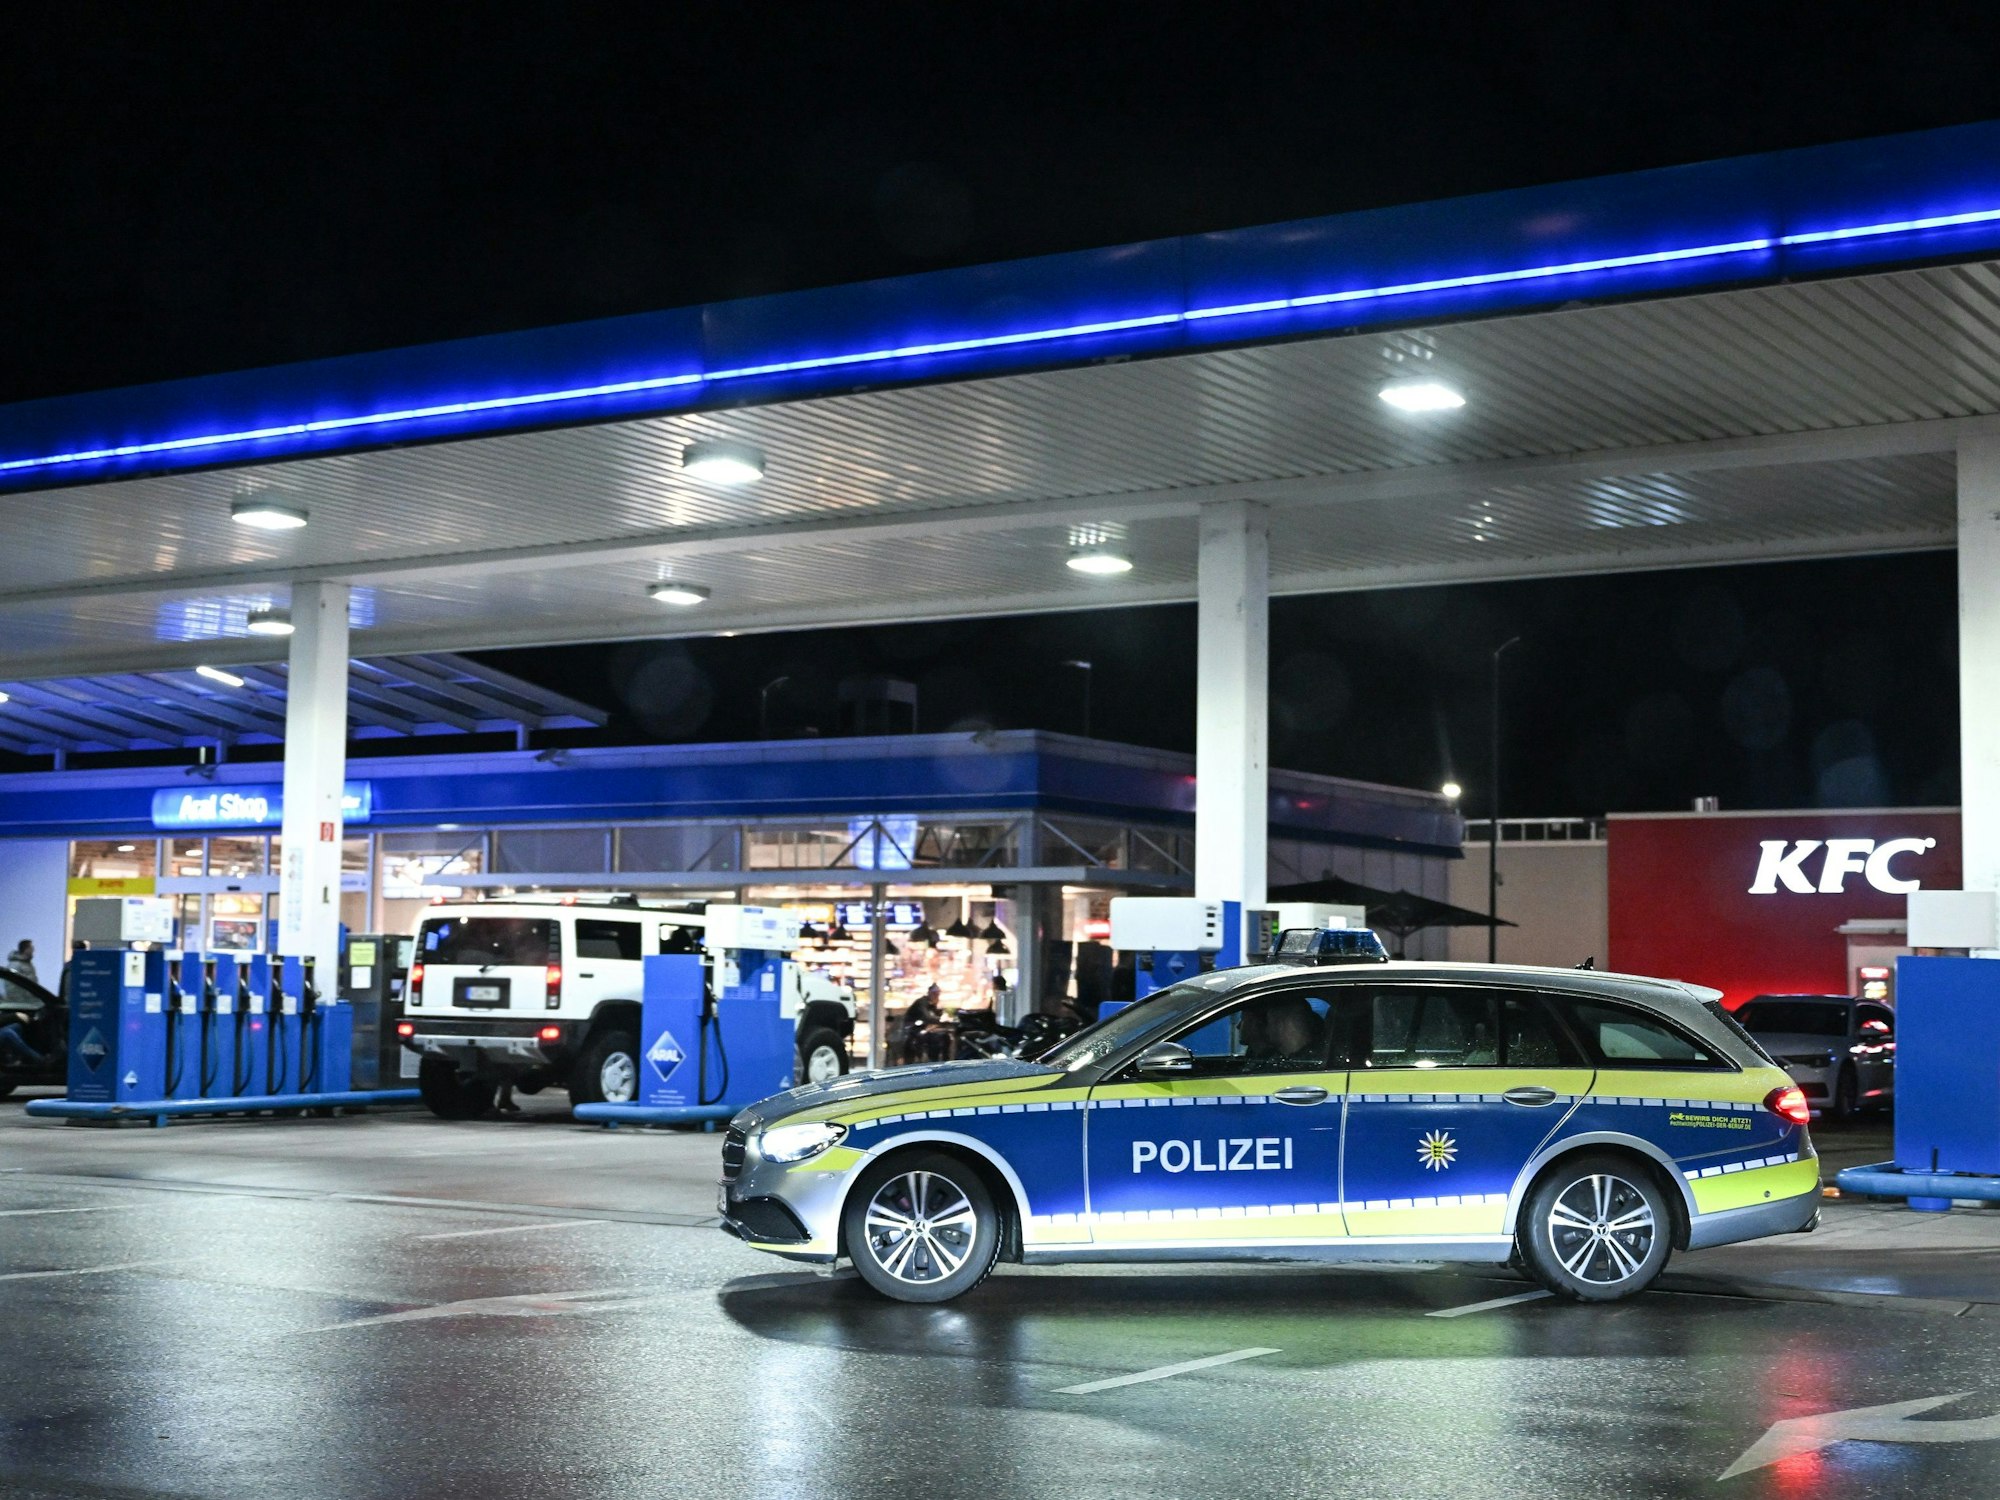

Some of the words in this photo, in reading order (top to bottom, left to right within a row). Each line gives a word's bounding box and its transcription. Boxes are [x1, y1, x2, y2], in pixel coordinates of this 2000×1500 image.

[179, 794, 217, 820] Aral
[219, 793, 268, 822] Shop
[1748, 837, 1936, 894] KFC
[652, 1049, 680, 1062] ARAL
[1132, 1137, 1293, 1173] POLIZEI
